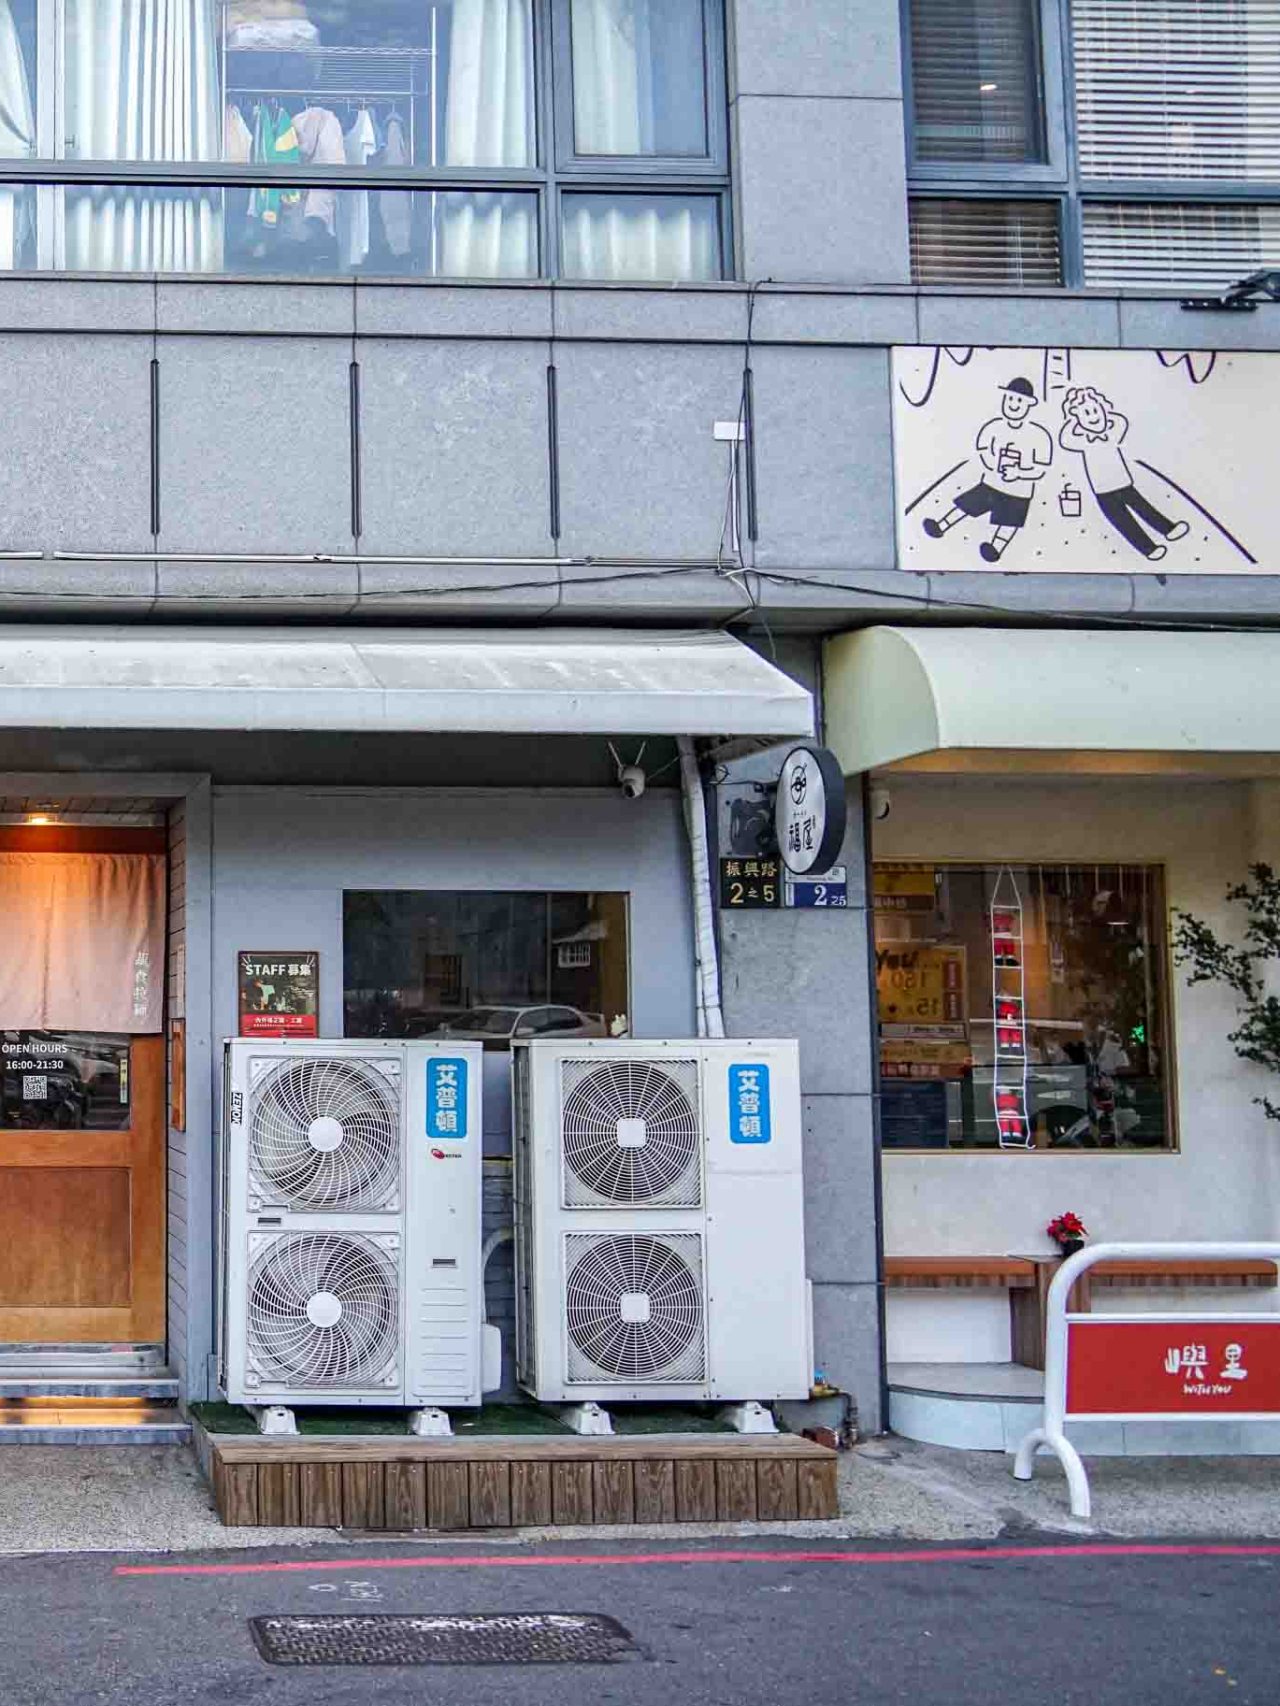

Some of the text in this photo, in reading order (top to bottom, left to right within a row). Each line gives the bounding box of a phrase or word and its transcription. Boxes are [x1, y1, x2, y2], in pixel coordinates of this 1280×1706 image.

[726, 861, 777, 877] 振興路
[731, 882, 774, 904] 2之5
[246, 963, 311, 976] STAFF 募集
[2, 1044, 68, 1053] OPEN HOURS
[6, 1061, 64, 1070] 16:00-21:30
[435, 1064, 458, 1133] 艾普頓
[738, 1070, 762, 1137] 艾普頓
[1212, 1384, 1232, 1395] YOU
